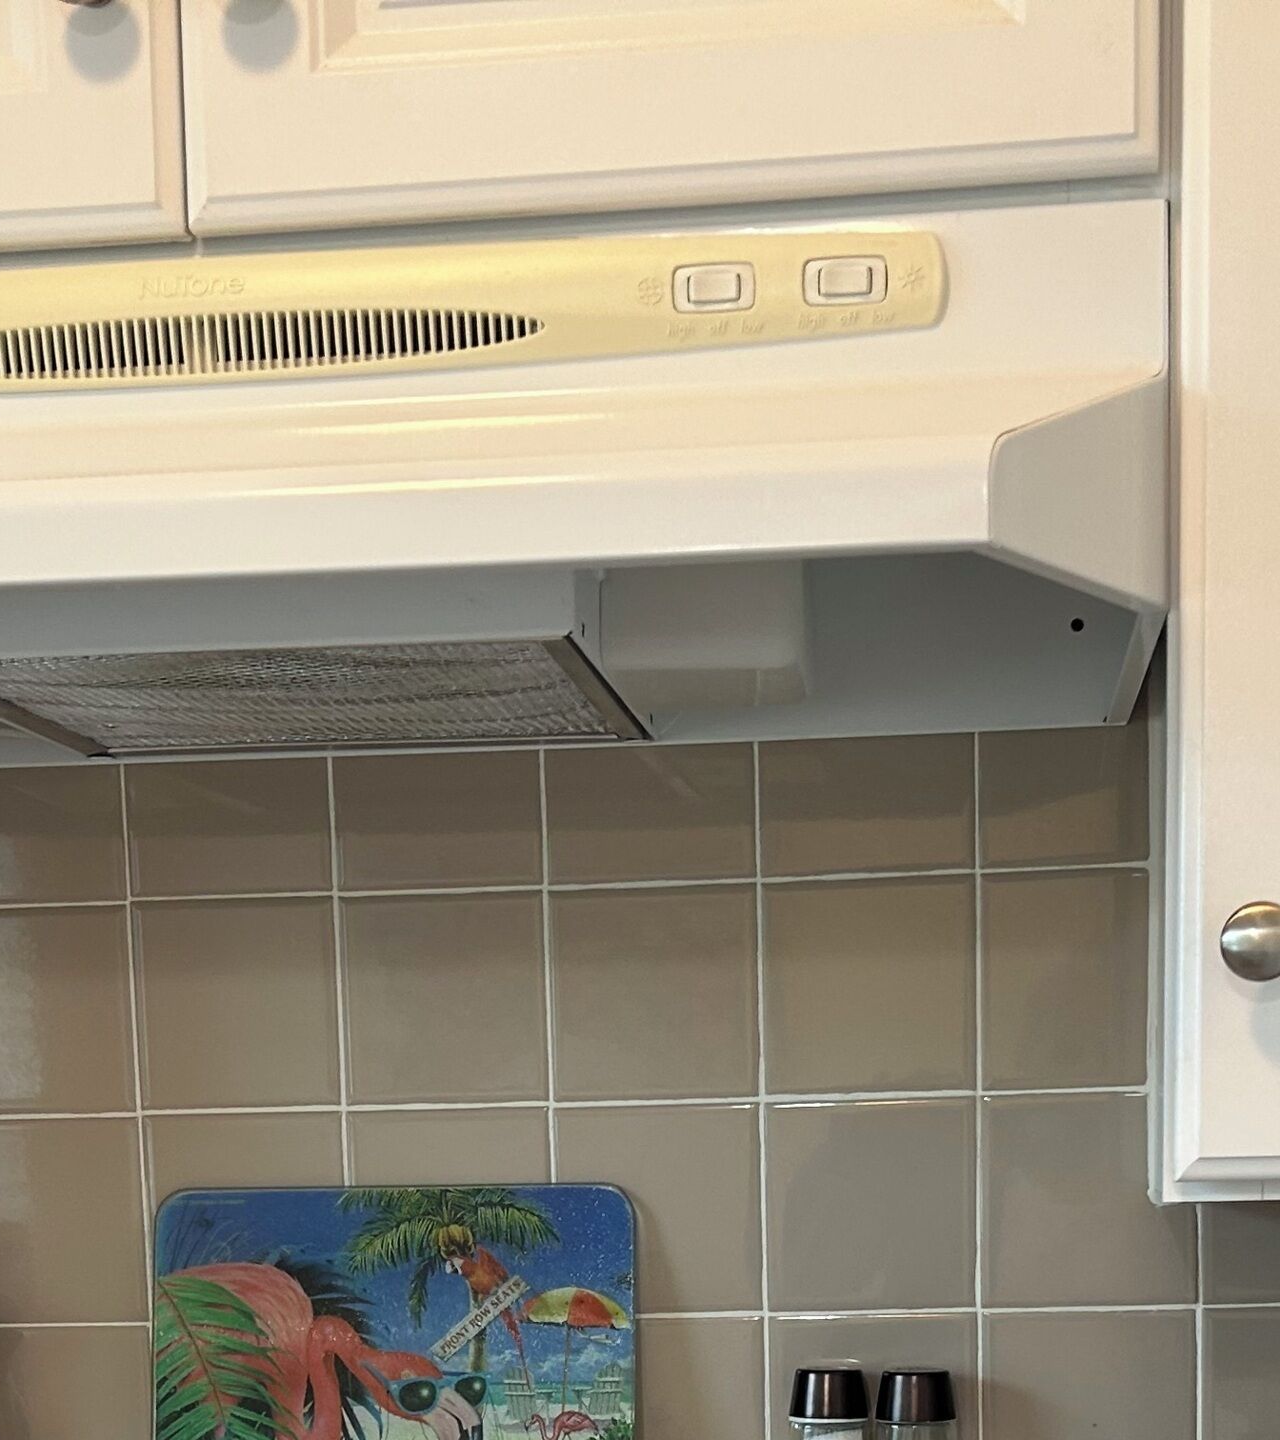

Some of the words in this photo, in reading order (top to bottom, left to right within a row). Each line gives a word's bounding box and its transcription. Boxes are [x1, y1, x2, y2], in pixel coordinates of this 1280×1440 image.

[139, 275, 245, 300] NuTone
[440, 1325, 470, 1354] FRONT
[469, 1306, 491, 1329] ROW
[491, 1280, 521, 1309] SEATS
